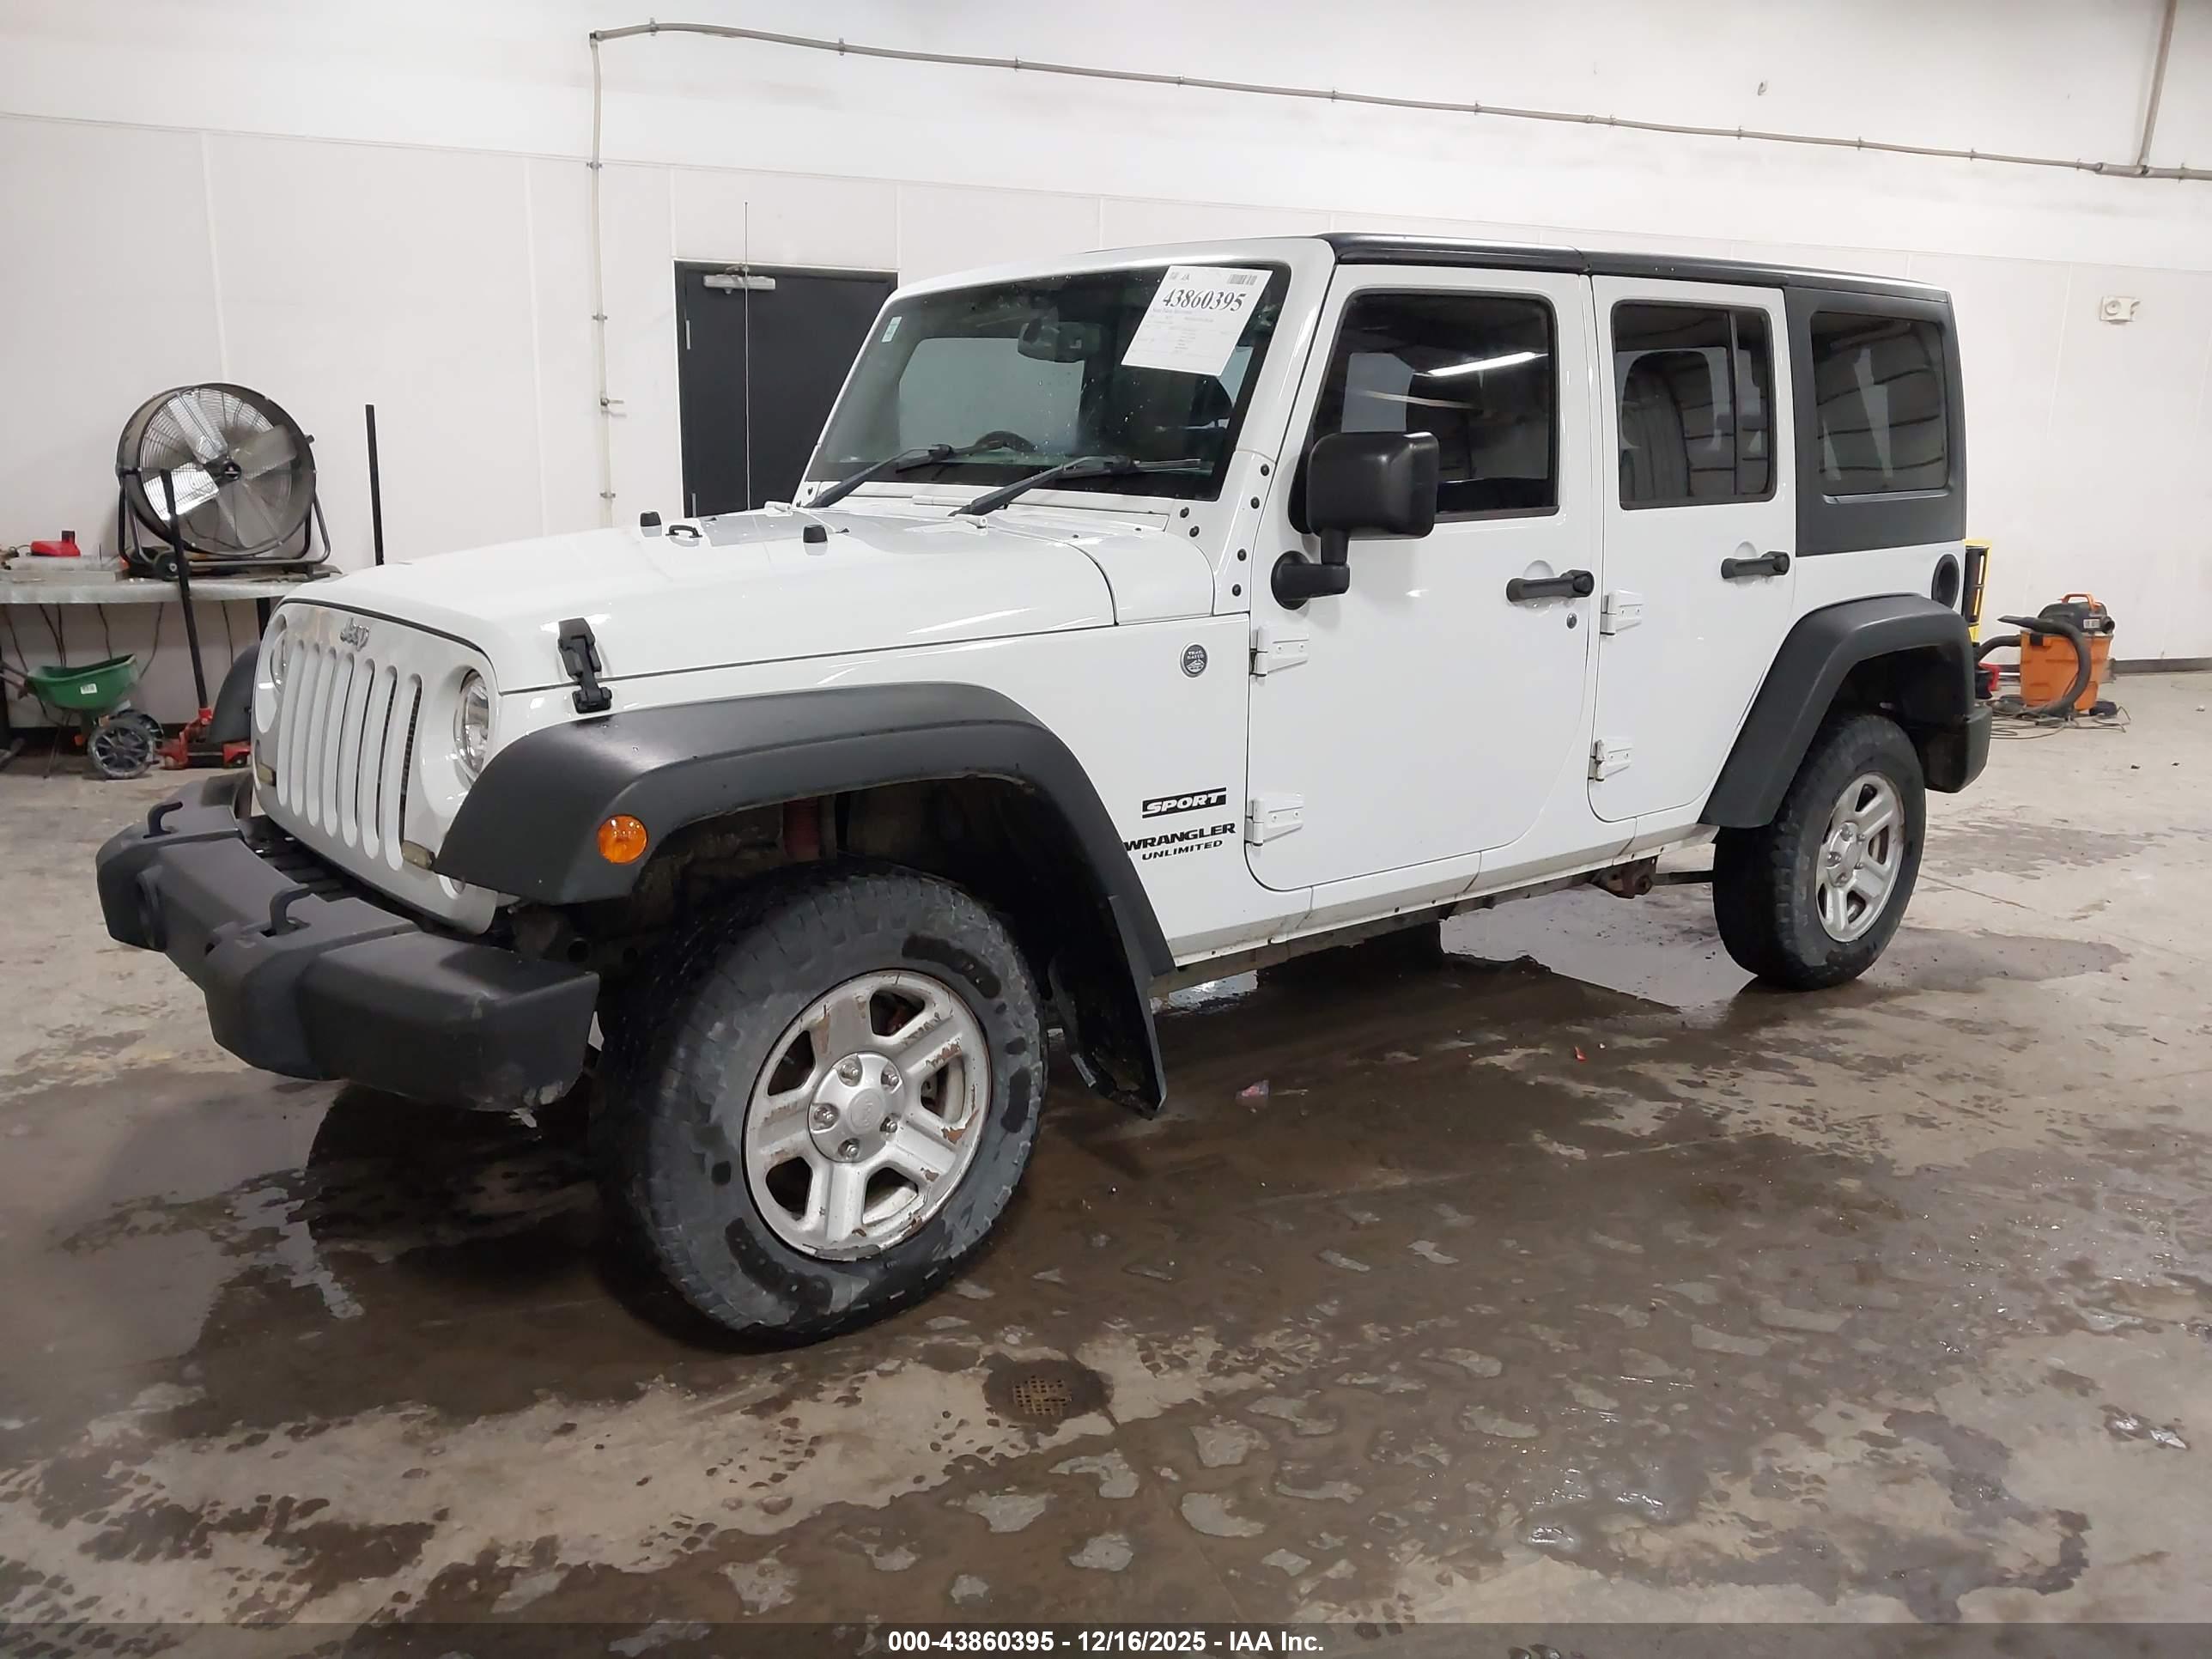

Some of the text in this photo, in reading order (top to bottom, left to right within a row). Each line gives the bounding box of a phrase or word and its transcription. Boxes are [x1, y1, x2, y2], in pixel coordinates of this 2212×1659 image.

[1163, 288, 1247, 312] 43860395
[1143, 790, 1226, 815] SPORT
[1123, 823, 1237, 851] WRANGLER
[1141, 840, 1223, 860] UNLIMITED
